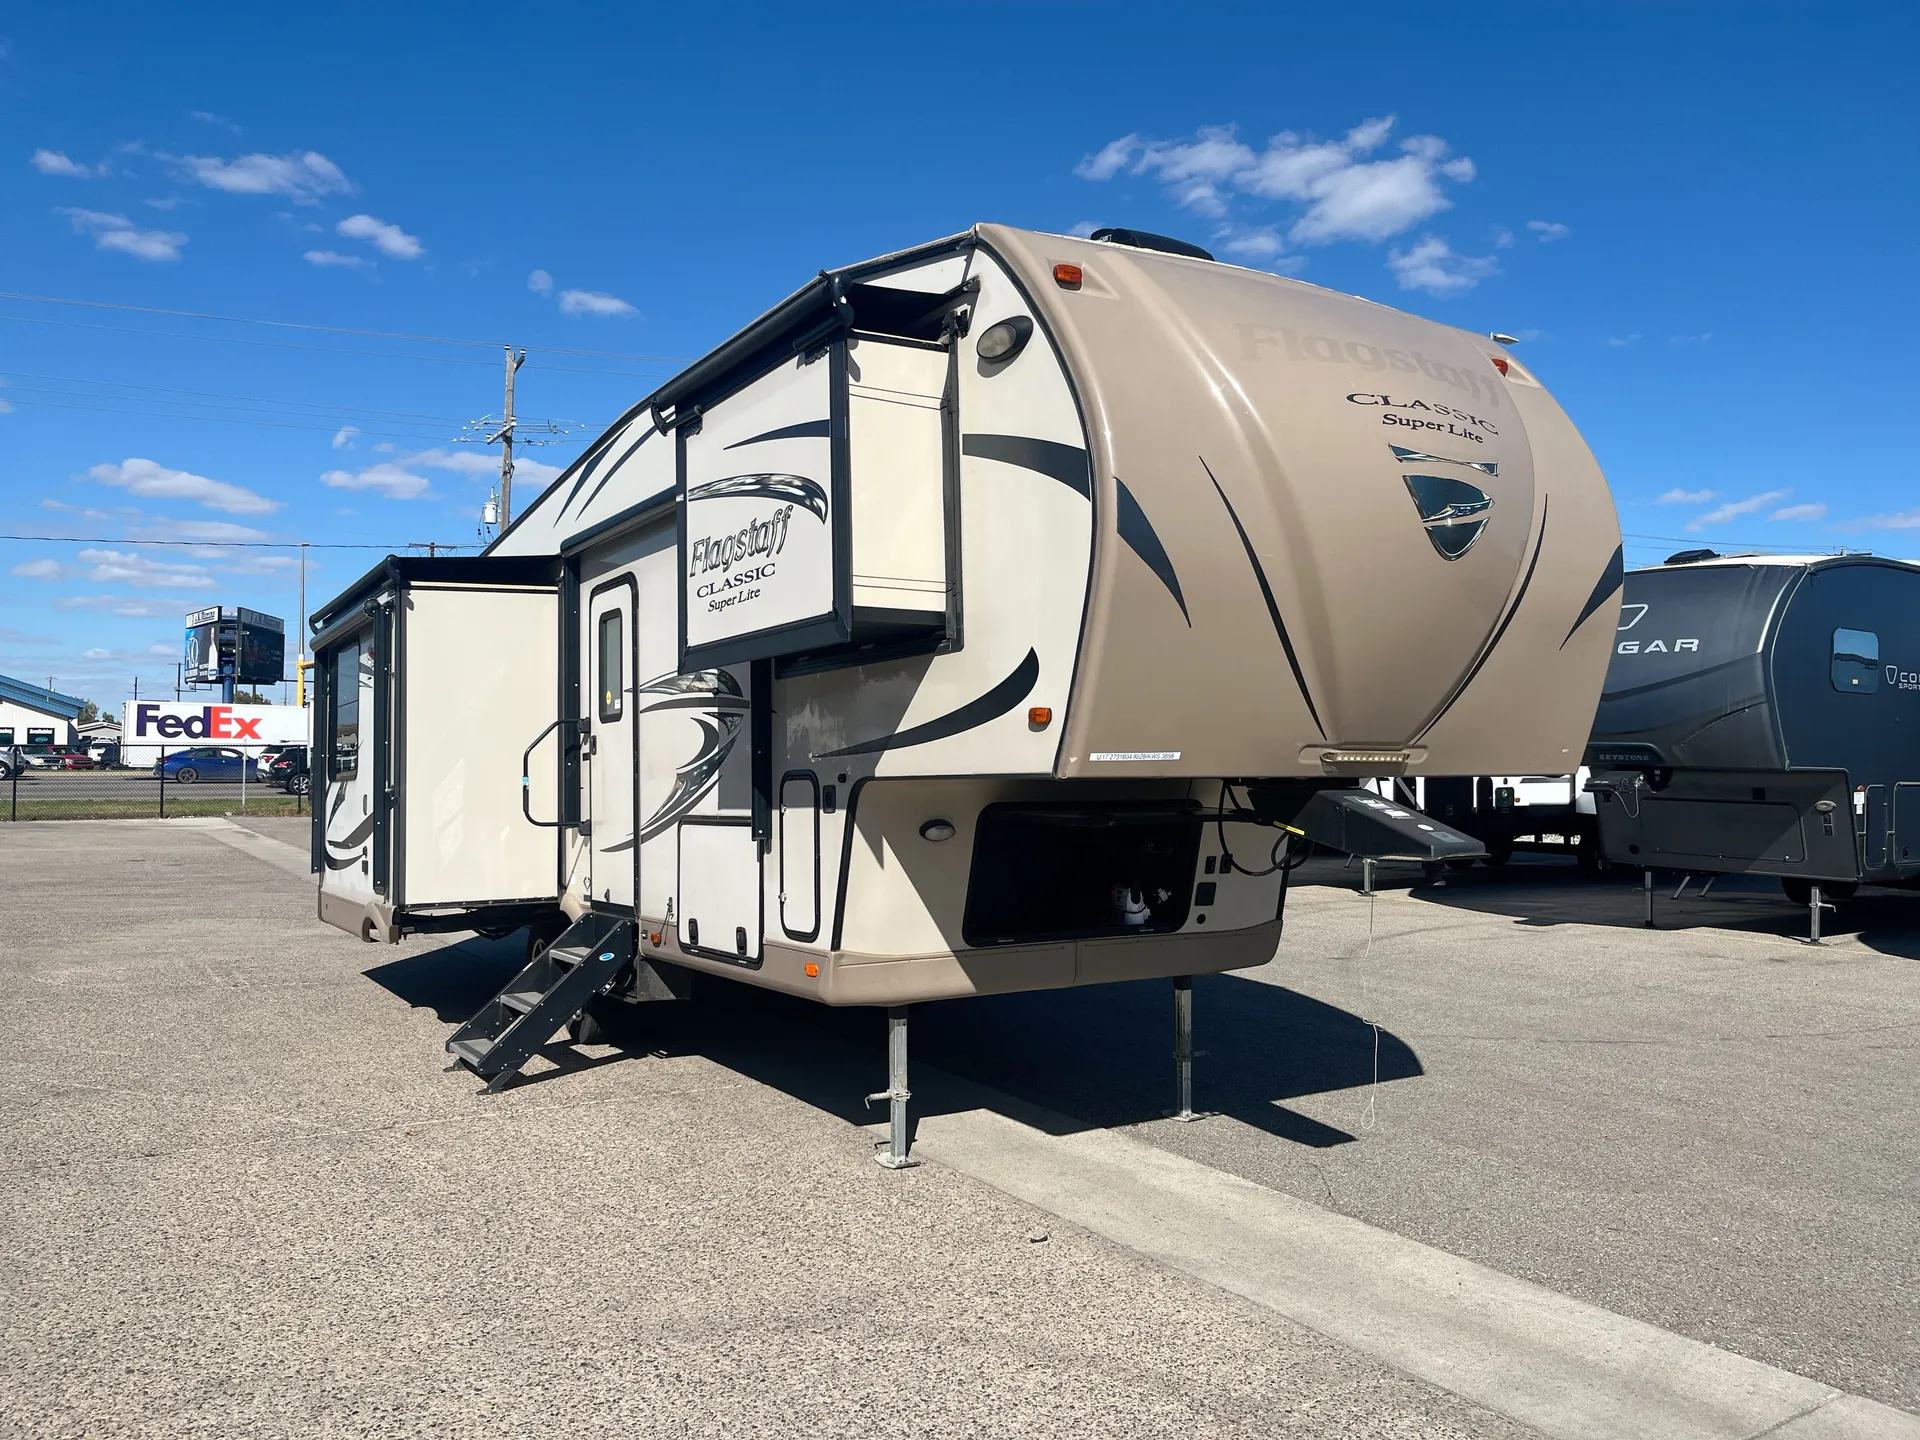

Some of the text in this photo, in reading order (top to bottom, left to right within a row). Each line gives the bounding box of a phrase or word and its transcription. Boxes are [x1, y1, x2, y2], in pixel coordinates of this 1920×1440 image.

[1234, 323, 1500, 408] Flagstaff
[1346, 393, 1499, 436] CLASSIC
[1382, 413, 1484, 444] Super Lite
[689, 504, 794, 578] Flagstaff
[696, 562, 776, 599] CLASSIC
[707, 588, 761, 613] Super Lite
[1900, 672, 1920, 684] CO
[136, 704, 263, 740] FedEx
